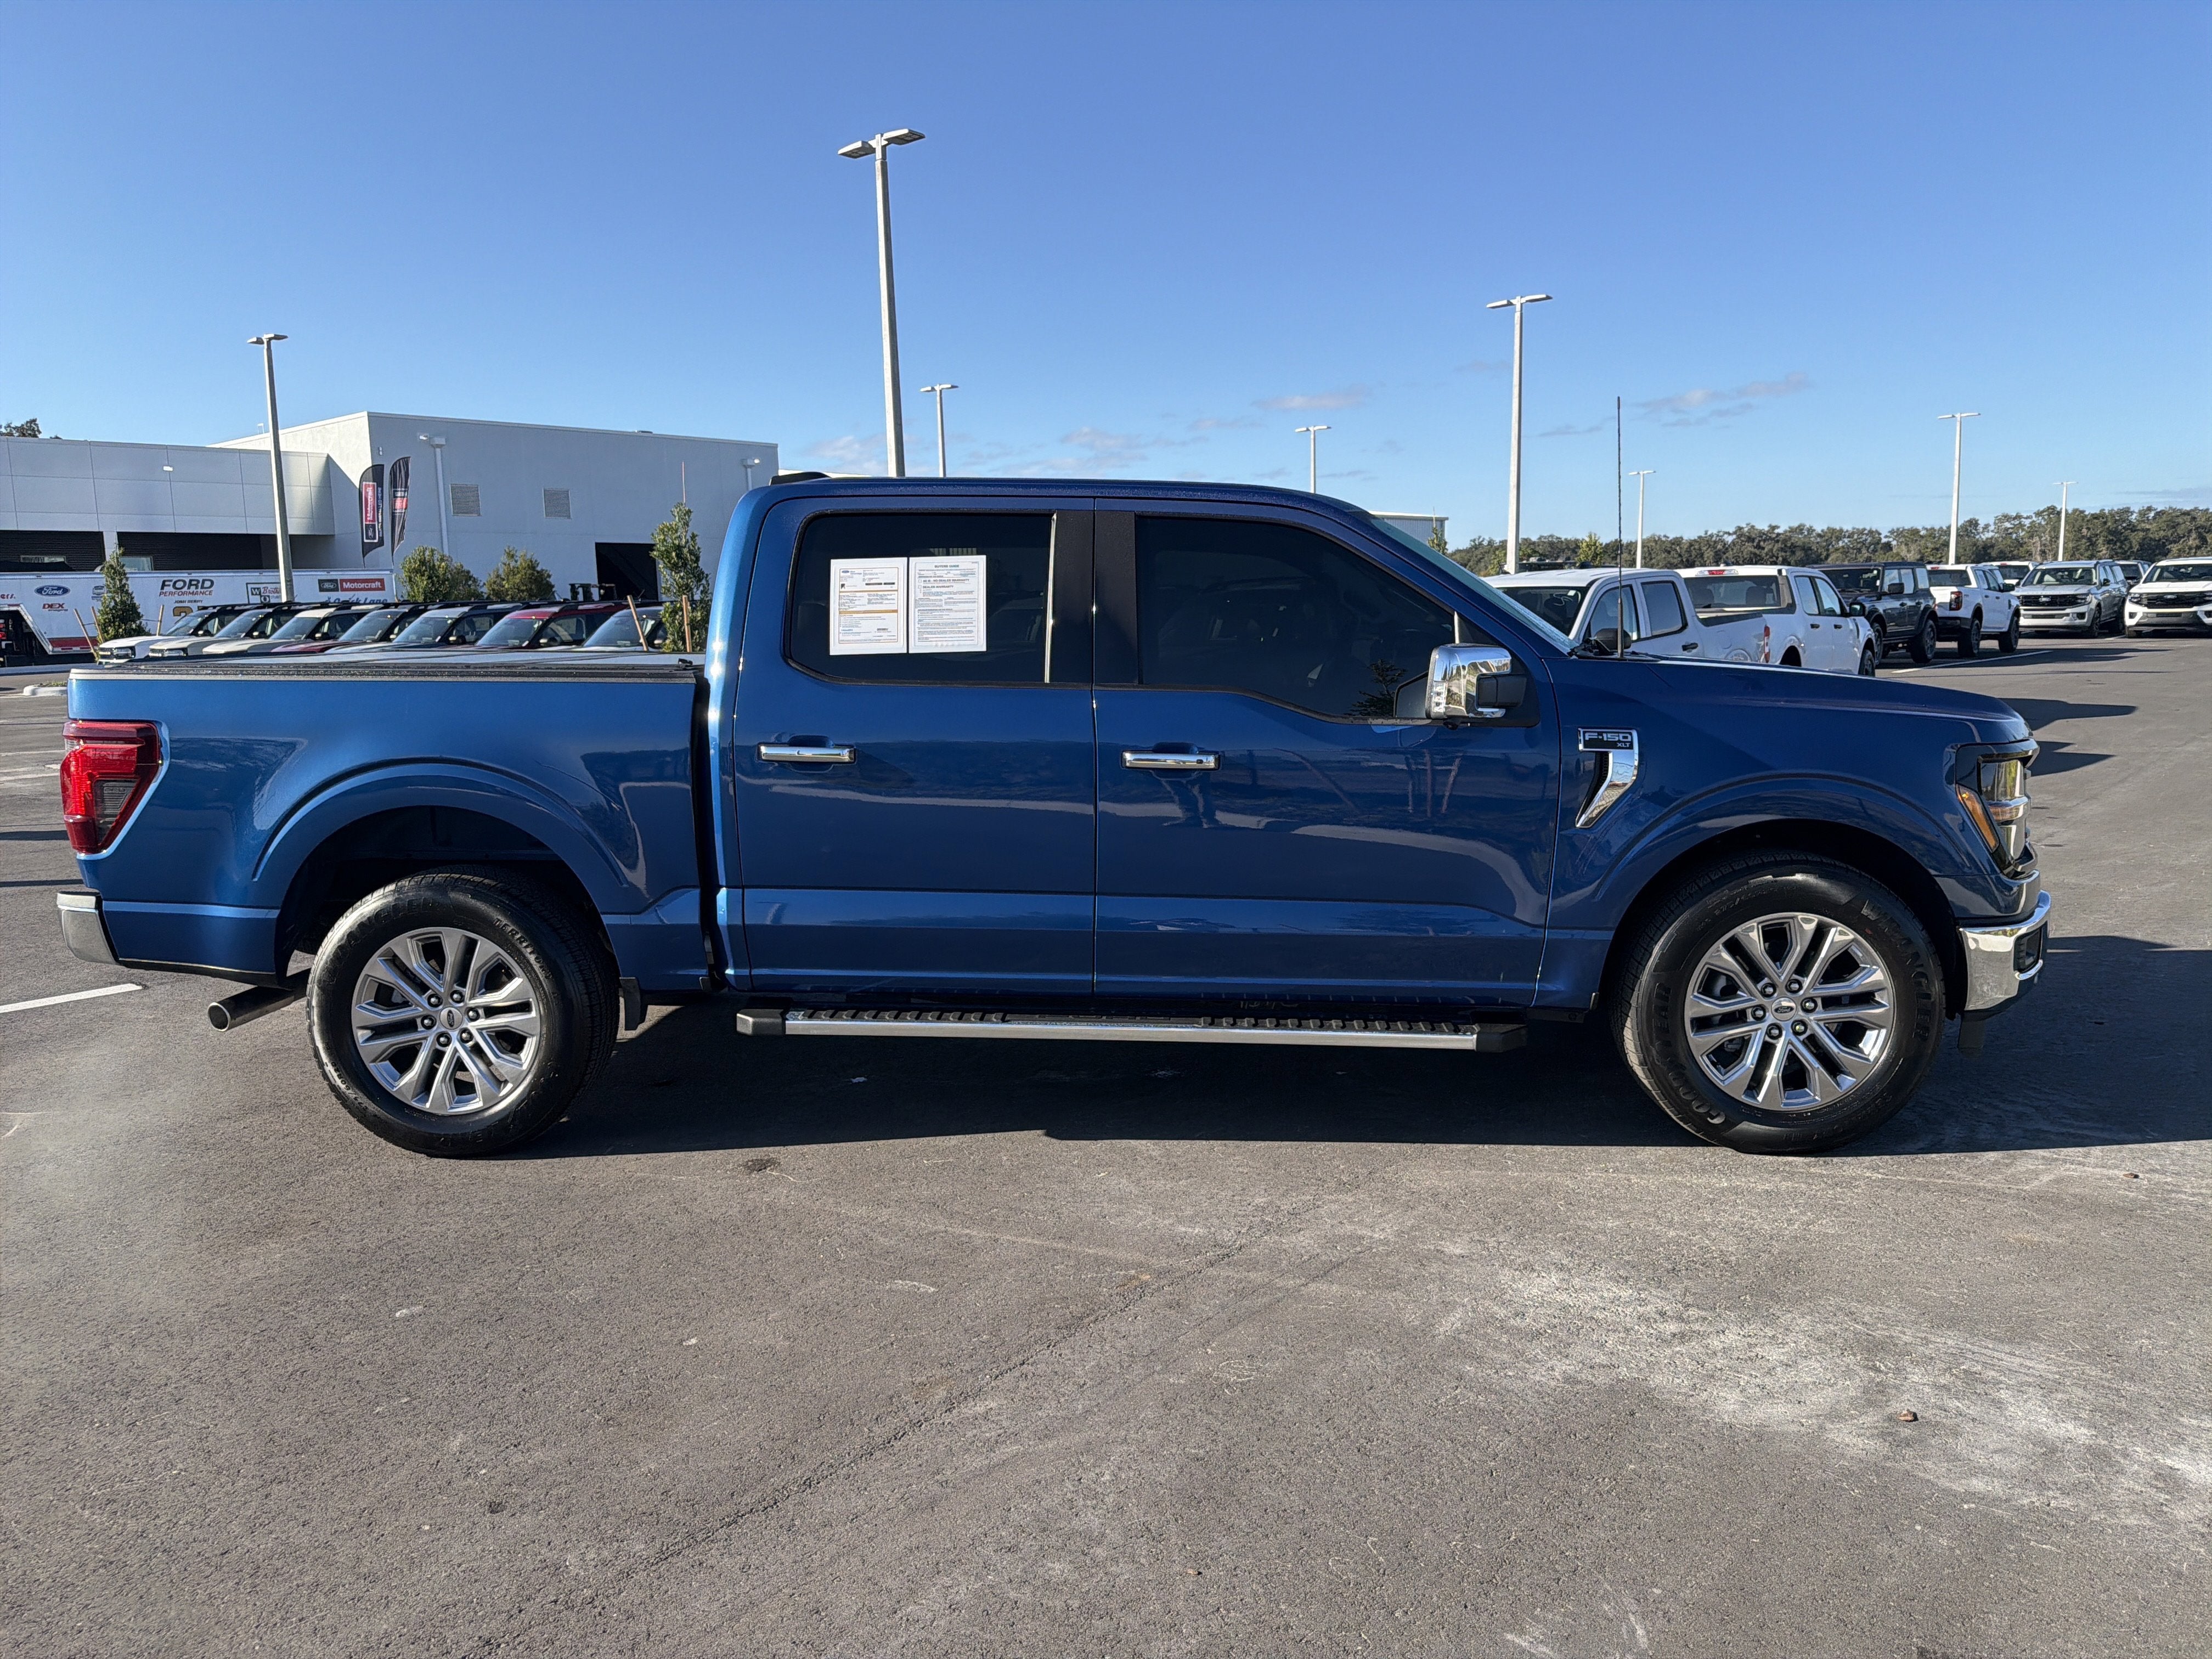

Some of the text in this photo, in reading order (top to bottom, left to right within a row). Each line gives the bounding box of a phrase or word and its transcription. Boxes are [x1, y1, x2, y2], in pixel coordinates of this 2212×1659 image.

[160, 579, 215, 590] FORD
[1585, 732, 1632, 741] F-150
[1860, 899, 1933, 1041] WRANGLER
[1652, 982, 1726, 1124] GOODYEAR
